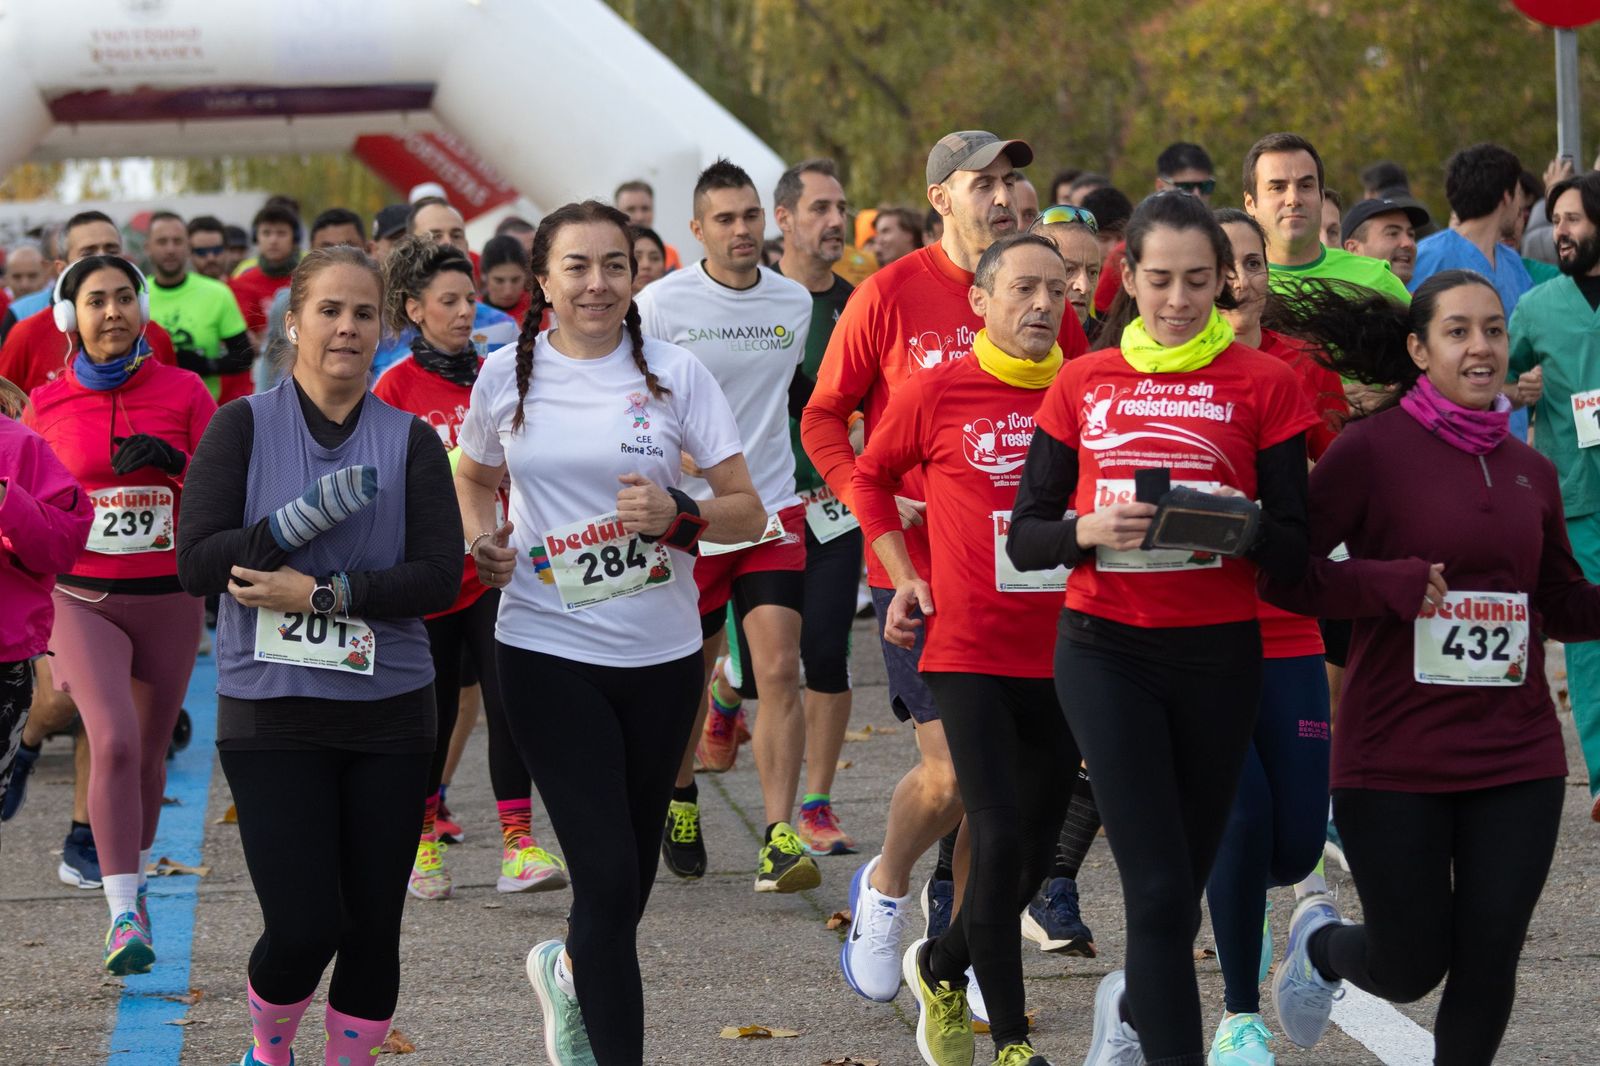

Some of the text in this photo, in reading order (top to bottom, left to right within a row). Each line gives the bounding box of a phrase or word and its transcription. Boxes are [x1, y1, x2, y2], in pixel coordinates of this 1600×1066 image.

[726, 338, 781, 352] TELECOM
[1134, 378, 1214, 399] ¡Corre sin
[621, 443, 645, 455] Reina
[103, 510, 154, 537] 239
[578, 538, 647, 586] 284
[282, 612, 347, 648] 201
[1442, 626, 1510, 661] 432
